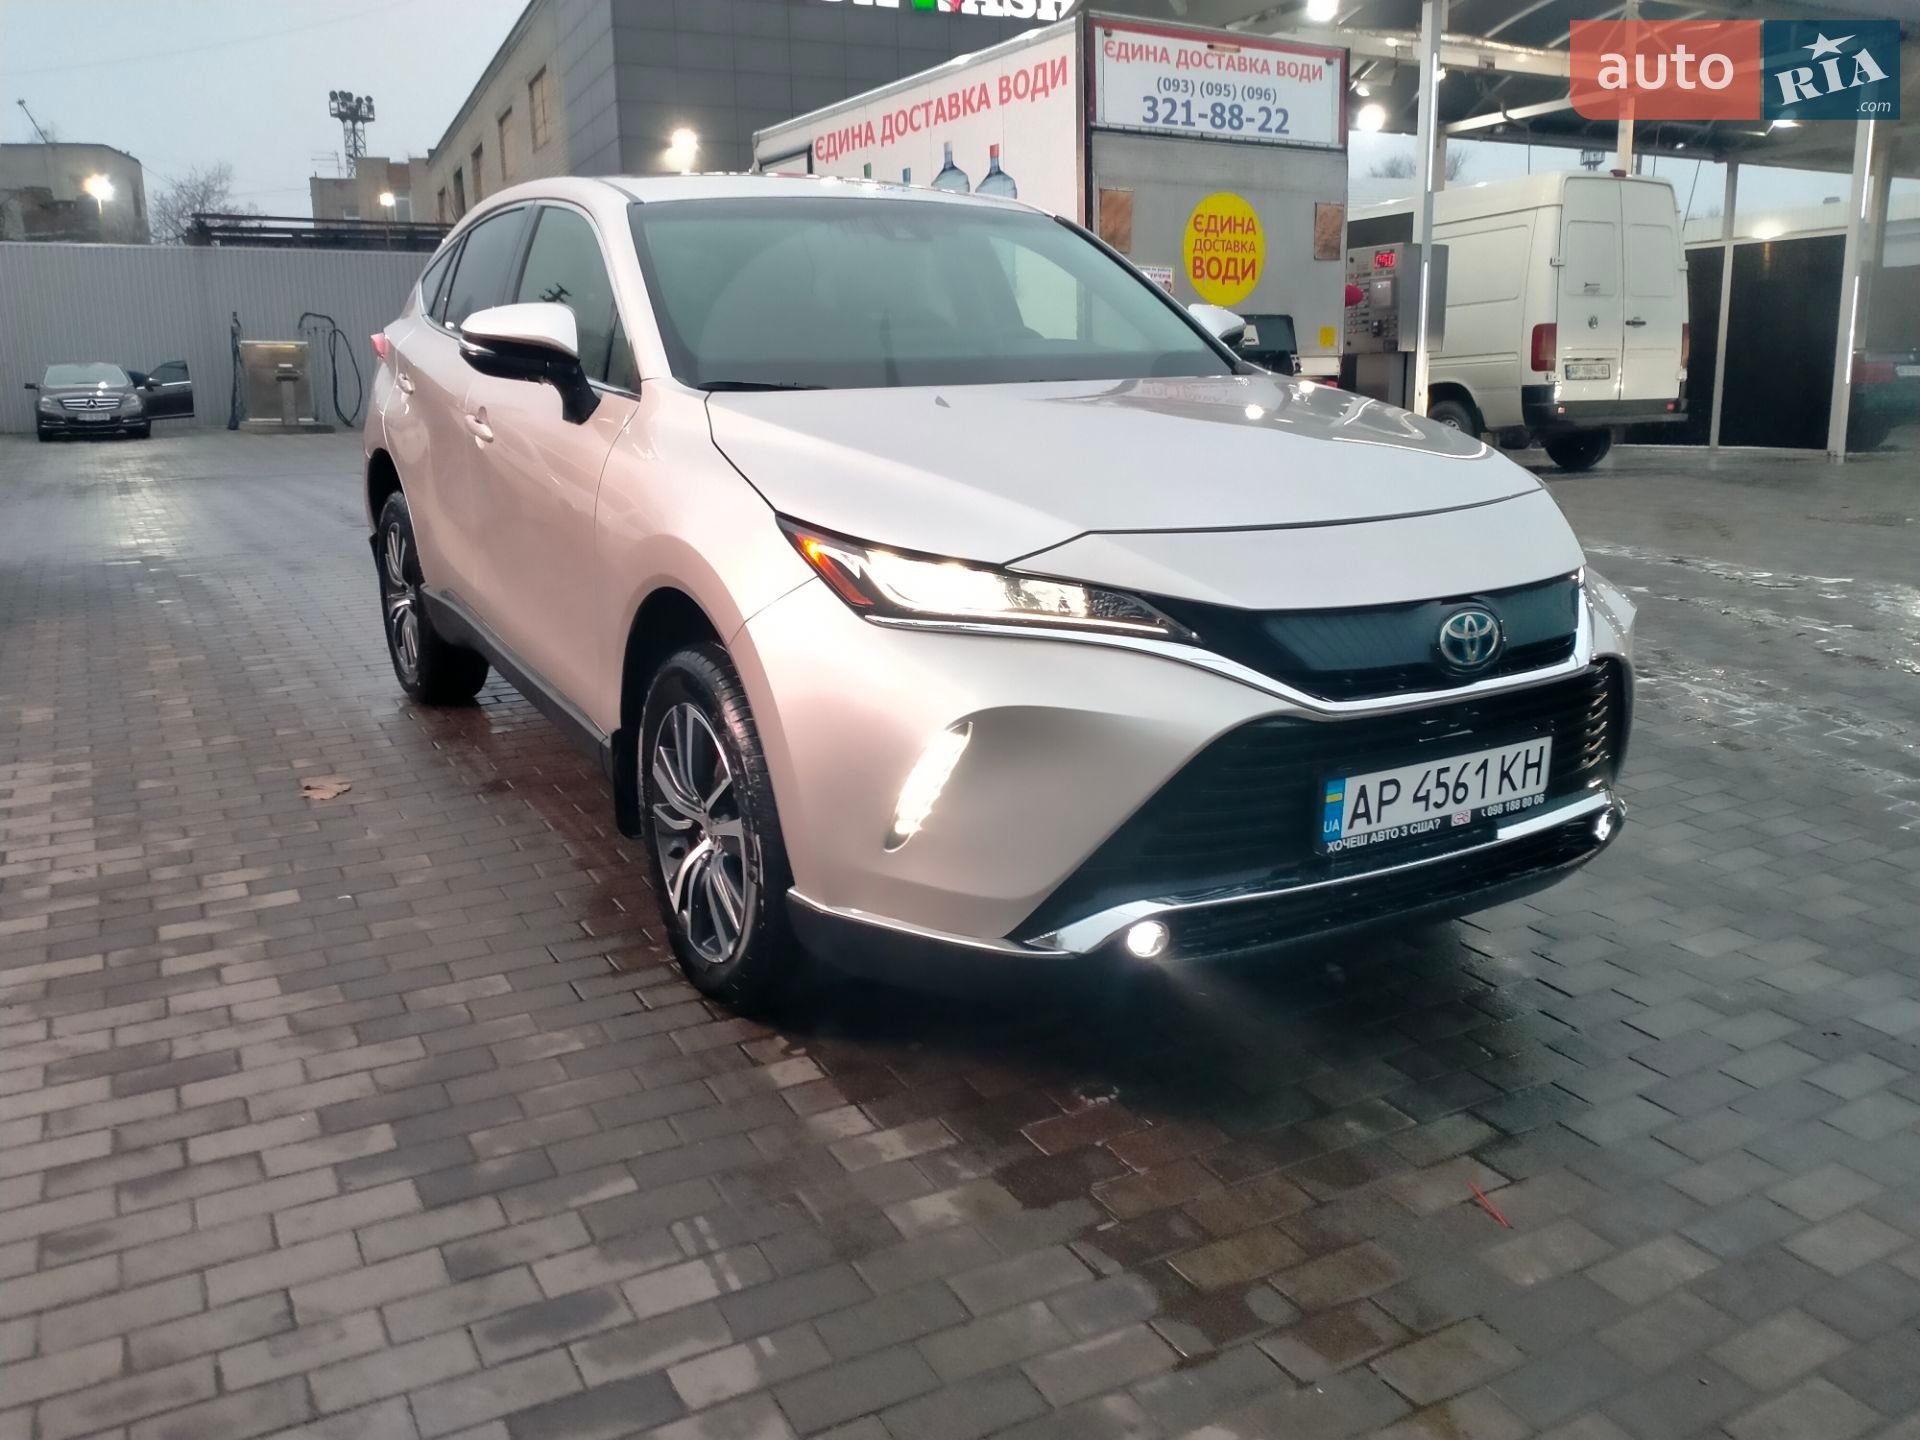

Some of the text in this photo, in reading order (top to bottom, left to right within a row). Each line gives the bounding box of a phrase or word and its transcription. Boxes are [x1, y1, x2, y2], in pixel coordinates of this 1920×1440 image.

[1104, 40, 1323, 83] ЄДИНА ДОСТАВКА ВОДИ
[1157, 76, 1277, 105] (093) (095) (096)
[815, 55, 1068, 164] ЄДИНА ДОСТАВКА ВОДИ
[1142, 95, 1290, 135] 321-88-22
[1193, 214, 1256, 238] ЄДИНА
[1193, 238, 1256, 254] ДОСТАВКА
[1192, 256, 1256, 286] ВОДИ
[1347, 745, 1545, 830] AP 4561 KH
[1323, 818, 1340, 833] UA
[1327, 834, 1368, 853] ХОЧЕШ
[1369, 828, 1399, 844] АВТО
[1410, 818, 1441, 834] США?
